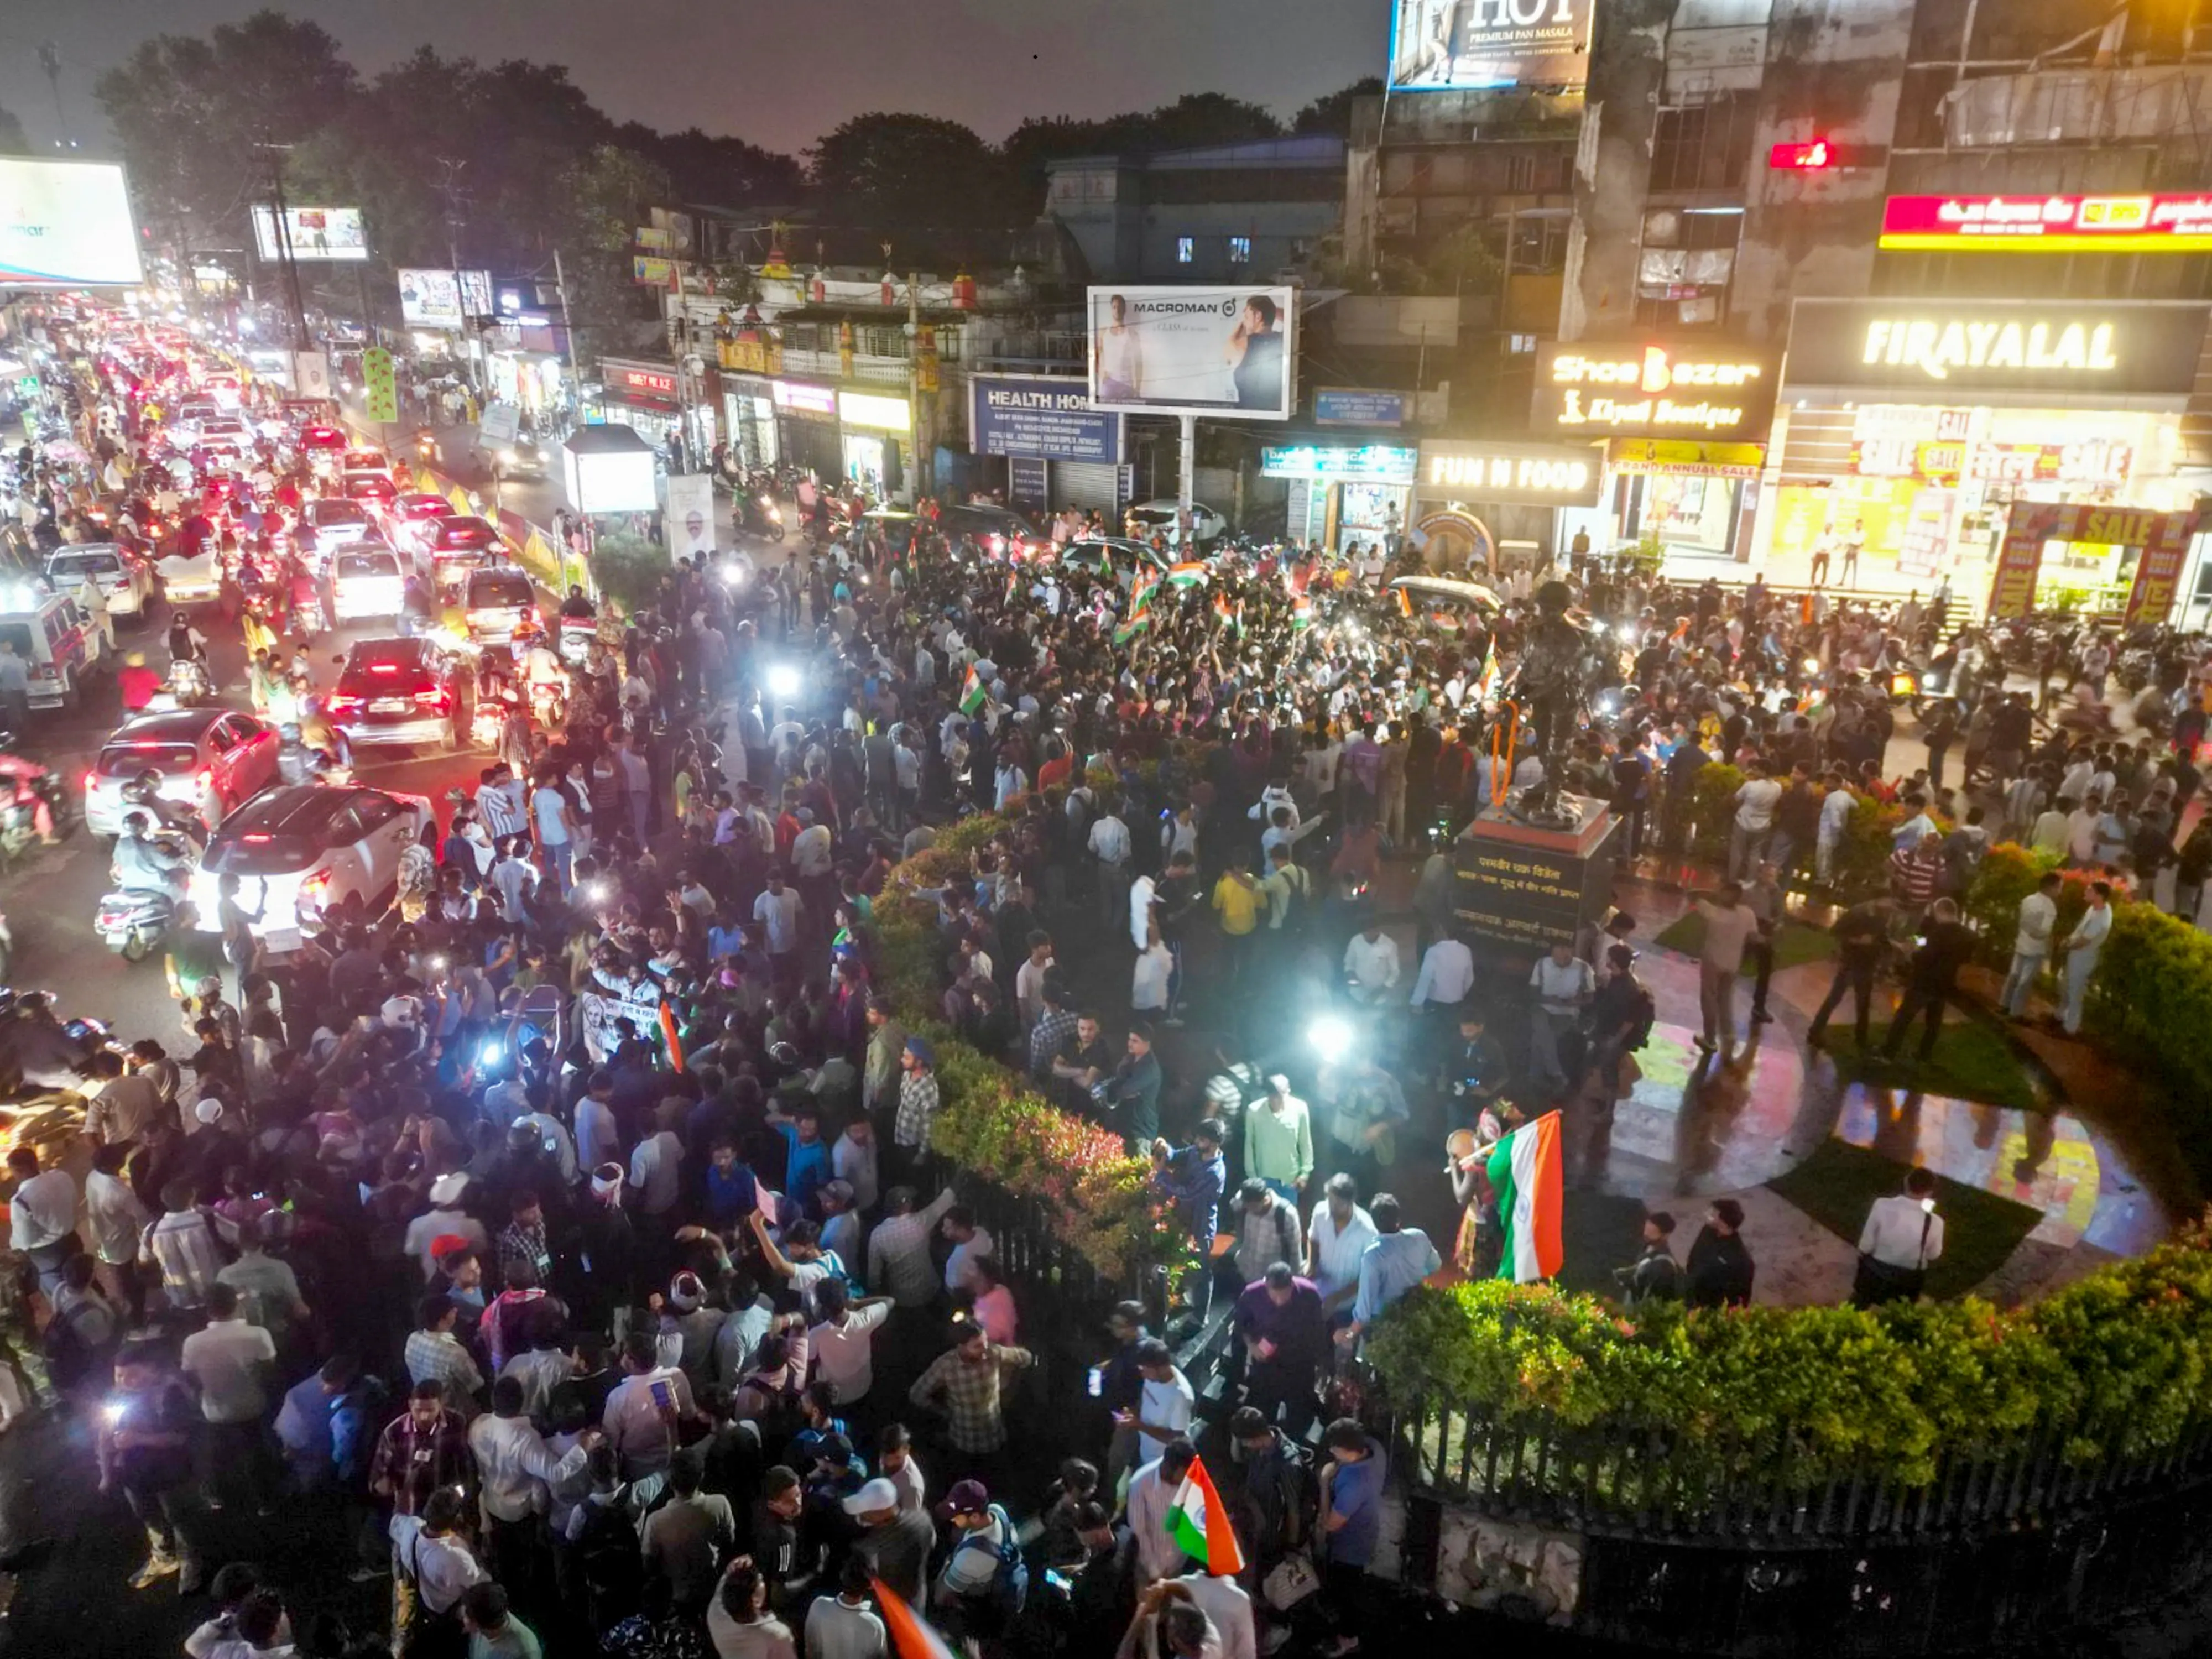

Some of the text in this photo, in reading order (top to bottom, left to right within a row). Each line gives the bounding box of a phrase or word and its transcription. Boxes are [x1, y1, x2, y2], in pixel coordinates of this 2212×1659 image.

[1470, 27, 1573, 43] PREMIUM PAN MASALA
[1134, 302, 1217, 314] MACROMAN
[1863, 320, 2117, 379] FIRAYALAL
[988, 390, 1052, 409] HEALTH
[1056, 394, 1091, 410] HOM
[1938, 411, 1969, 441] SAL
[1612, 461, 1756, 477] GRAND ANNUAL SALE
[1927, 449, 1961, 469] SALE
[1431, 456, 1588, 491] FUN N FOOD
[2085, 510, 2156, 546] SALE
[1997, 568, 2034, 618] SALE
